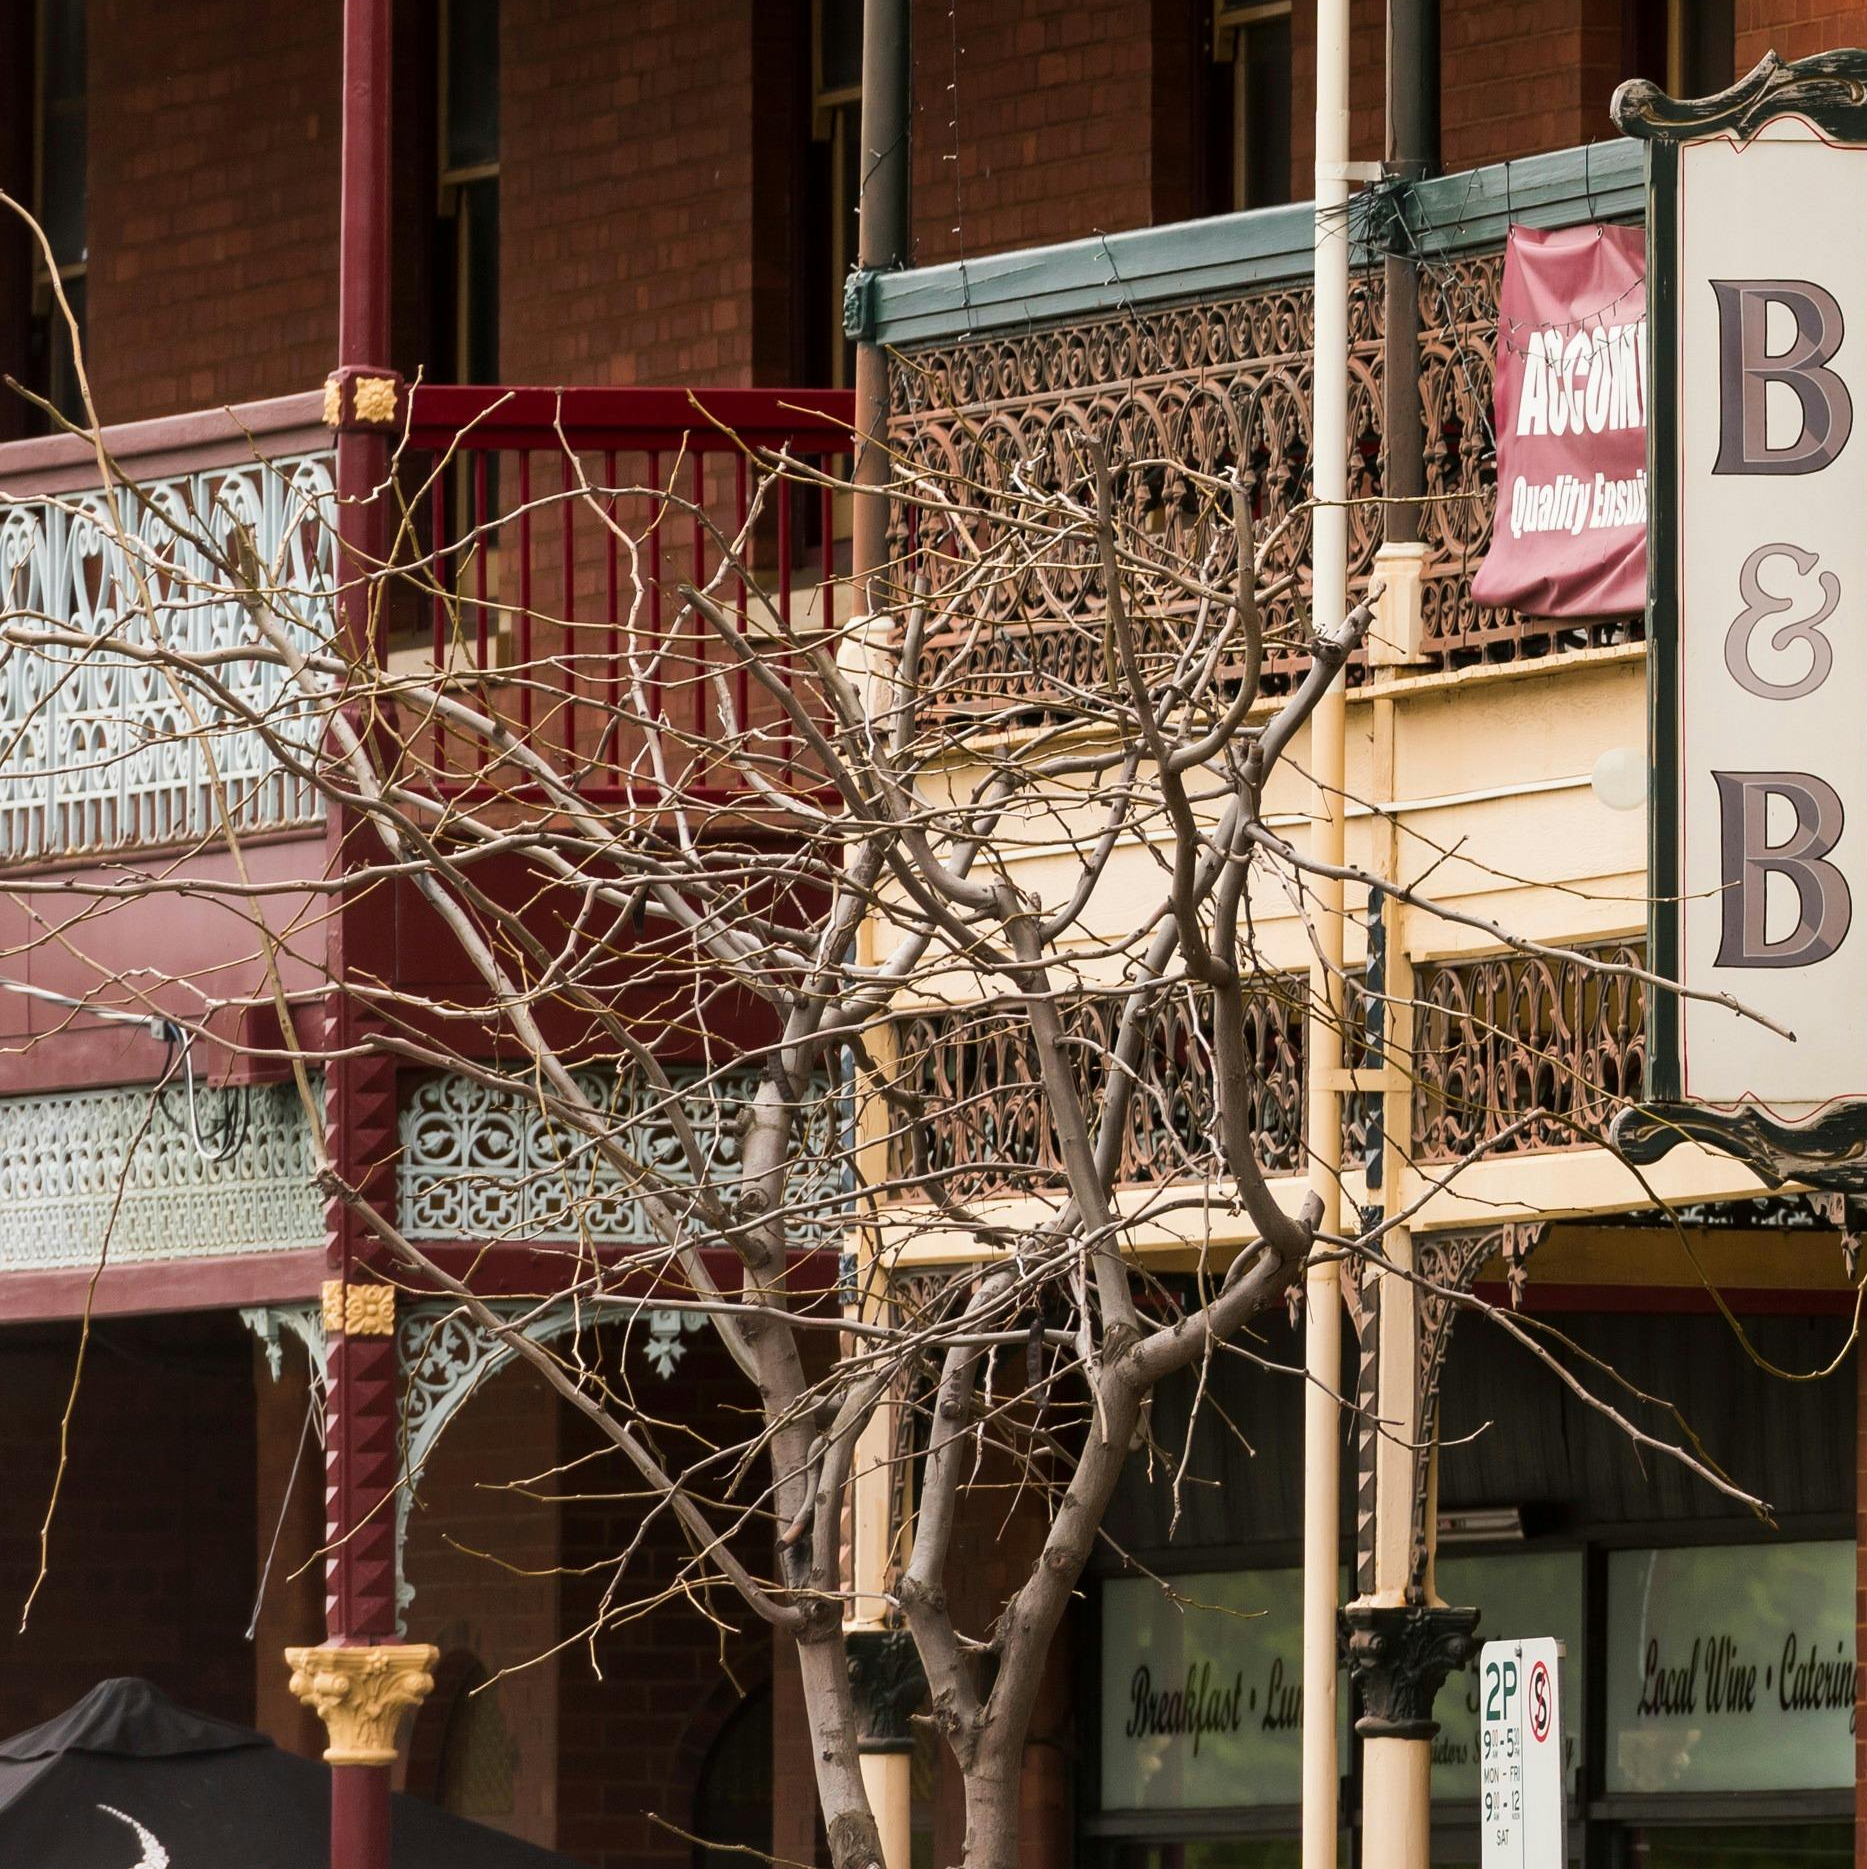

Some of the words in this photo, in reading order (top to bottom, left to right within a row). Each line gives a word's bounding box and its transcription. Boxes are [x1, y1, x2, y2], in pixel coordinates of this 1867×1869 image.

[1709, 279, 1854, 476] B
[1510, 474, 1592, 539] Quality
[1710, 770, 1853, 969] B
[1127, 1661, 1242, 1758] Breakfast
[1486, 1661, 1517, 1721] 2P
[1637, 1637, 1700, 1716] Local
[1705, 1635, 1757, 1714] Wine
[1484, 1768, 1499, 1783] MON
[1510, 1766, 1520, 1782] FRI
[1496, 1830, 1509, 1846] SAT
